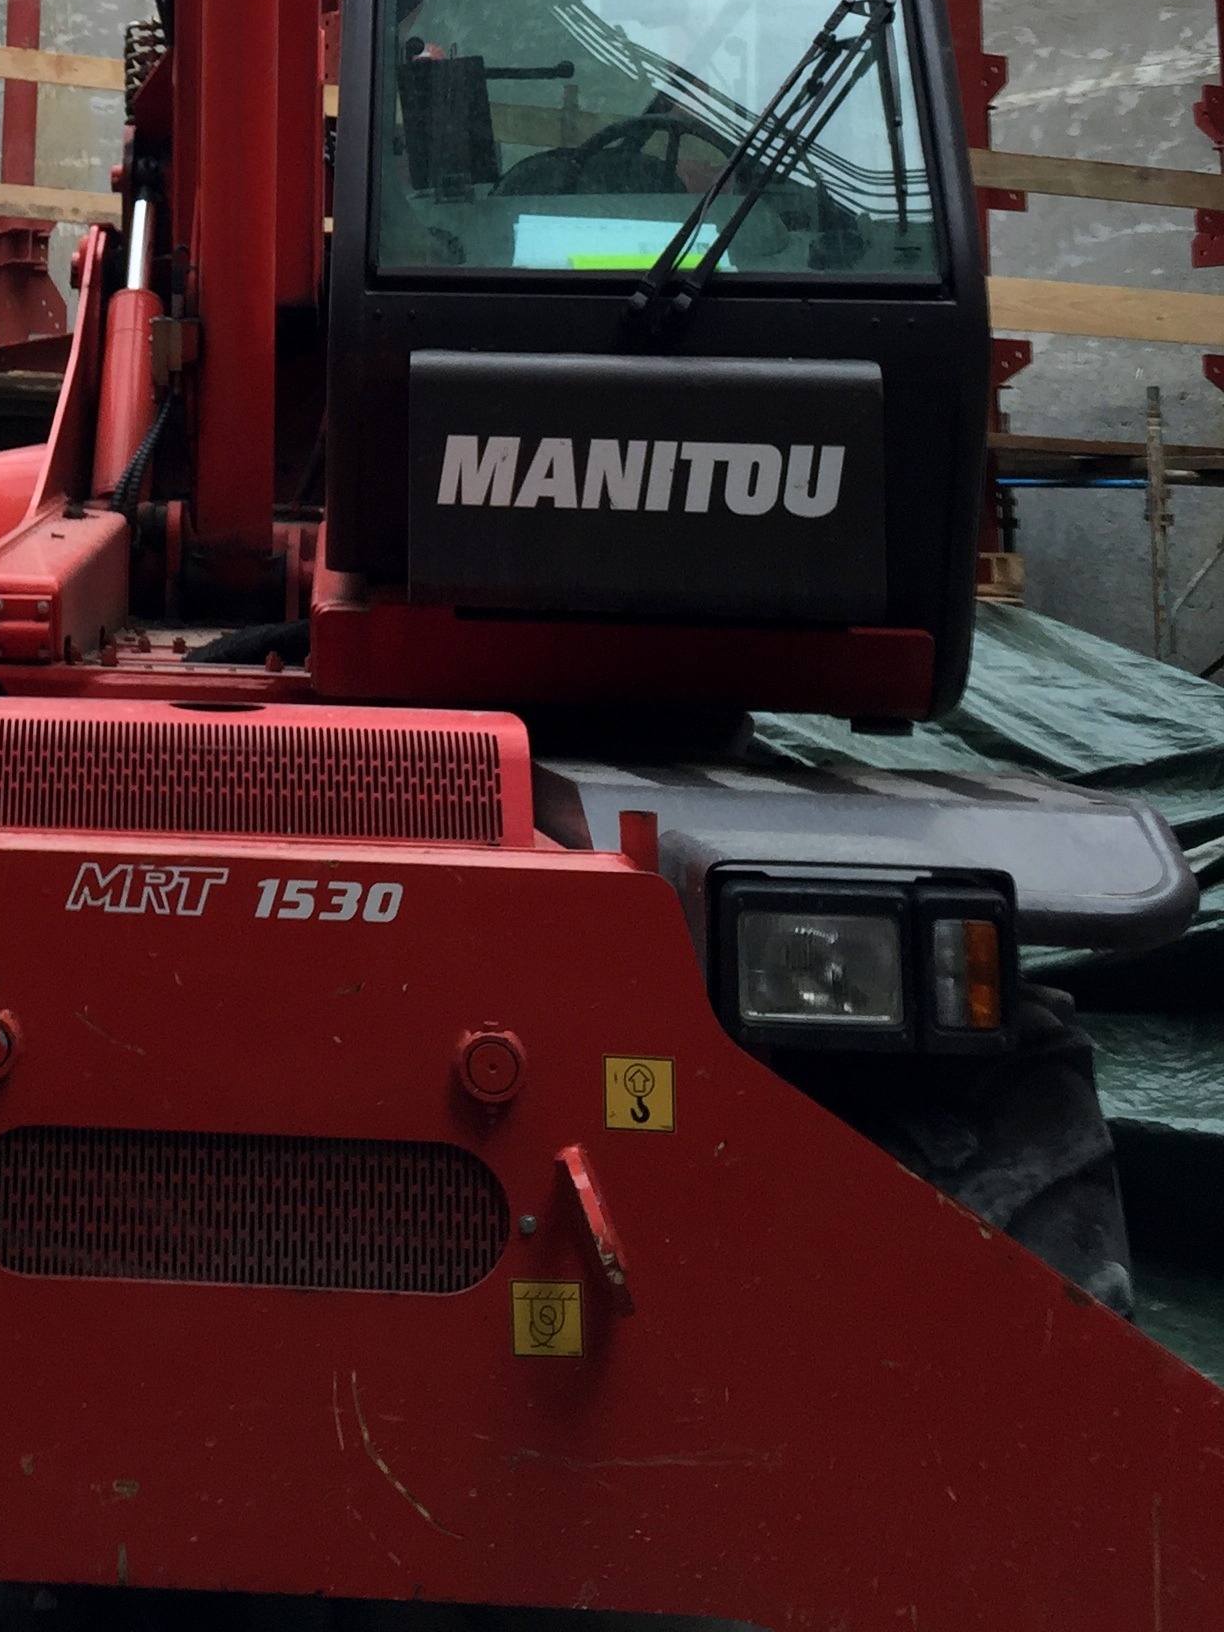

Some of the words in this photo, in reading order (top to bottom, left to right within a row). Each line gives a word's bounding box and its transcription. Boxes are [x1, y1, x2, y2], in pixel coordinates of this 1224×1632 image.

[438, 435, 845, 518] MANITOU
[65, 862, 230, 917] MRT
[254, 878, 404, 923] 1530
